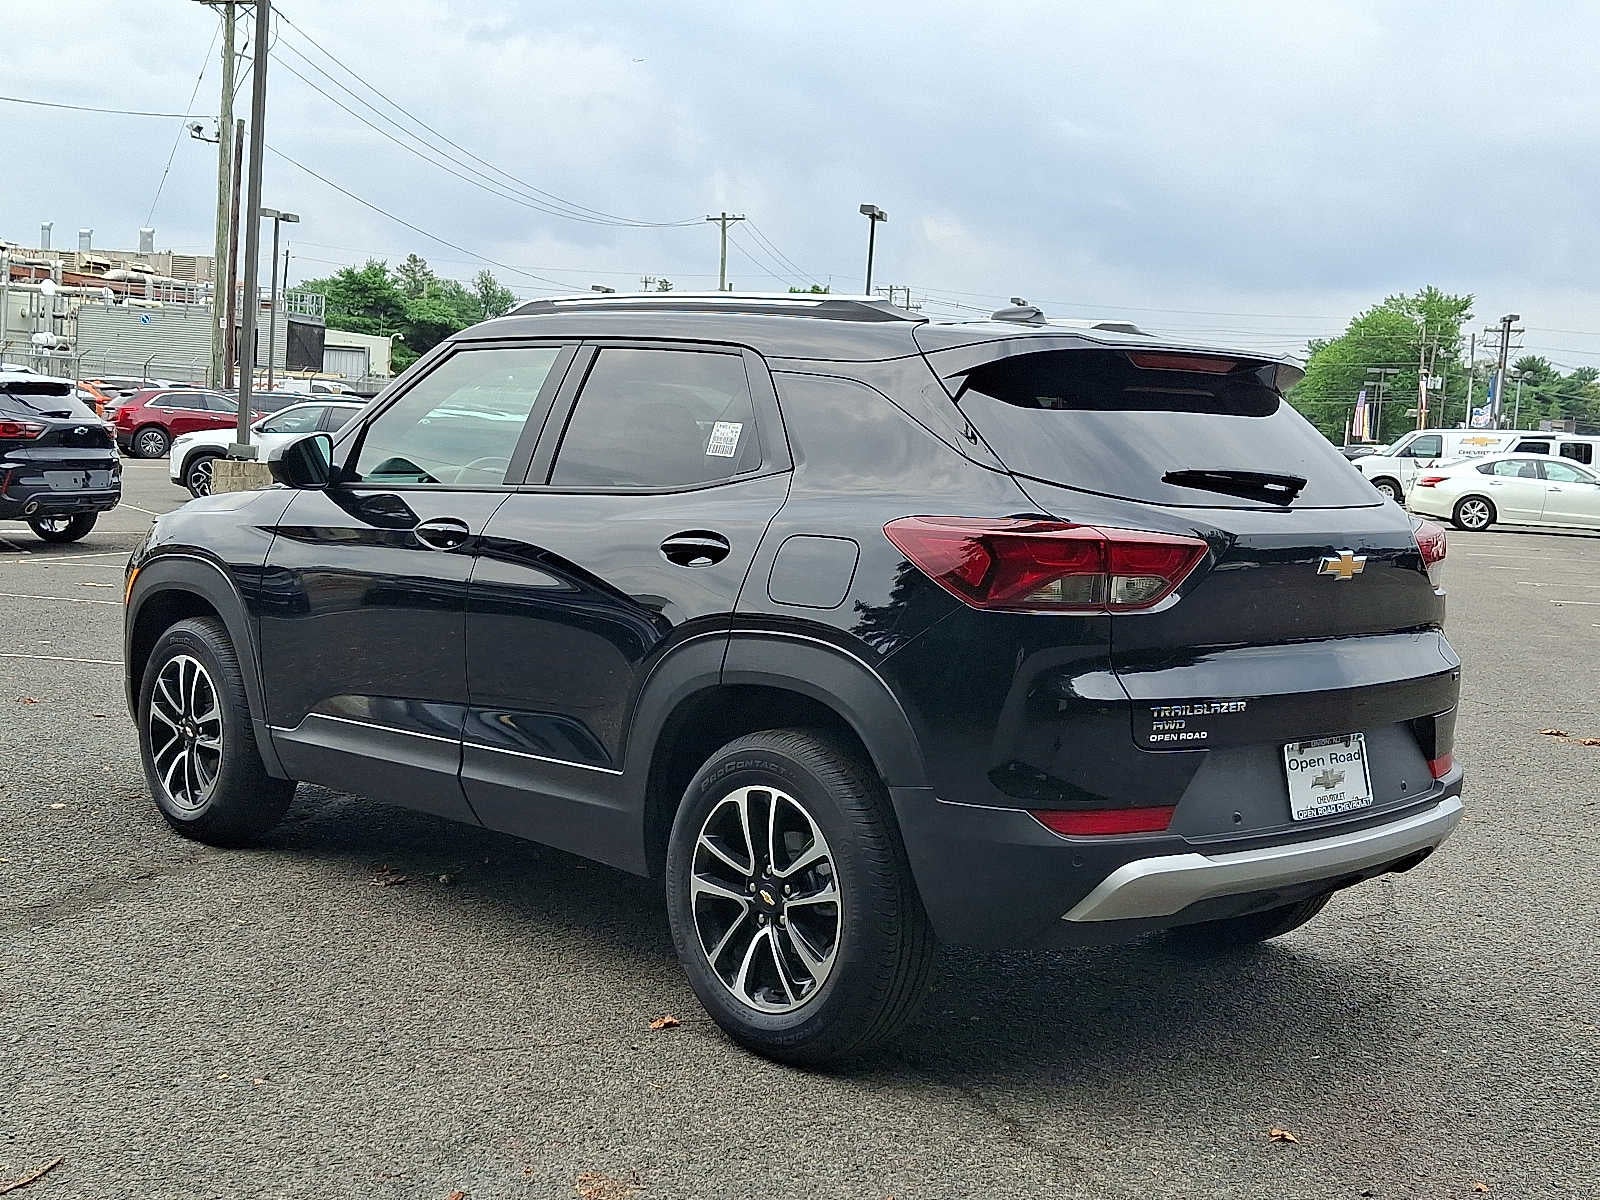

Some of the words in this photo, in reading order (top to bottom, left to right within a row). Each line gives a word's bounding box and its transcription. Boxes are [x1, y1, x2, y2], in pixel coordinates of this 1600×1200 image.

[1150, 701, 1247, 718] TRAILBLAZER
[1152, 719, 1186, 731] AWD
[1149, 733, 1178, 742] OPEN
[1179, 731, 1208, 740] ROAD
[1288, 757, 1325, 773] Open
[1329, 749, 1361, 765] Road
[1317, 792, 1345, 804] CHEVROLET
[1298, 808, 1318, 819] OPEN
[1318, 804, 1337, 815] ROAD
[1337, 797, 1371, 811] CHEVROLET
